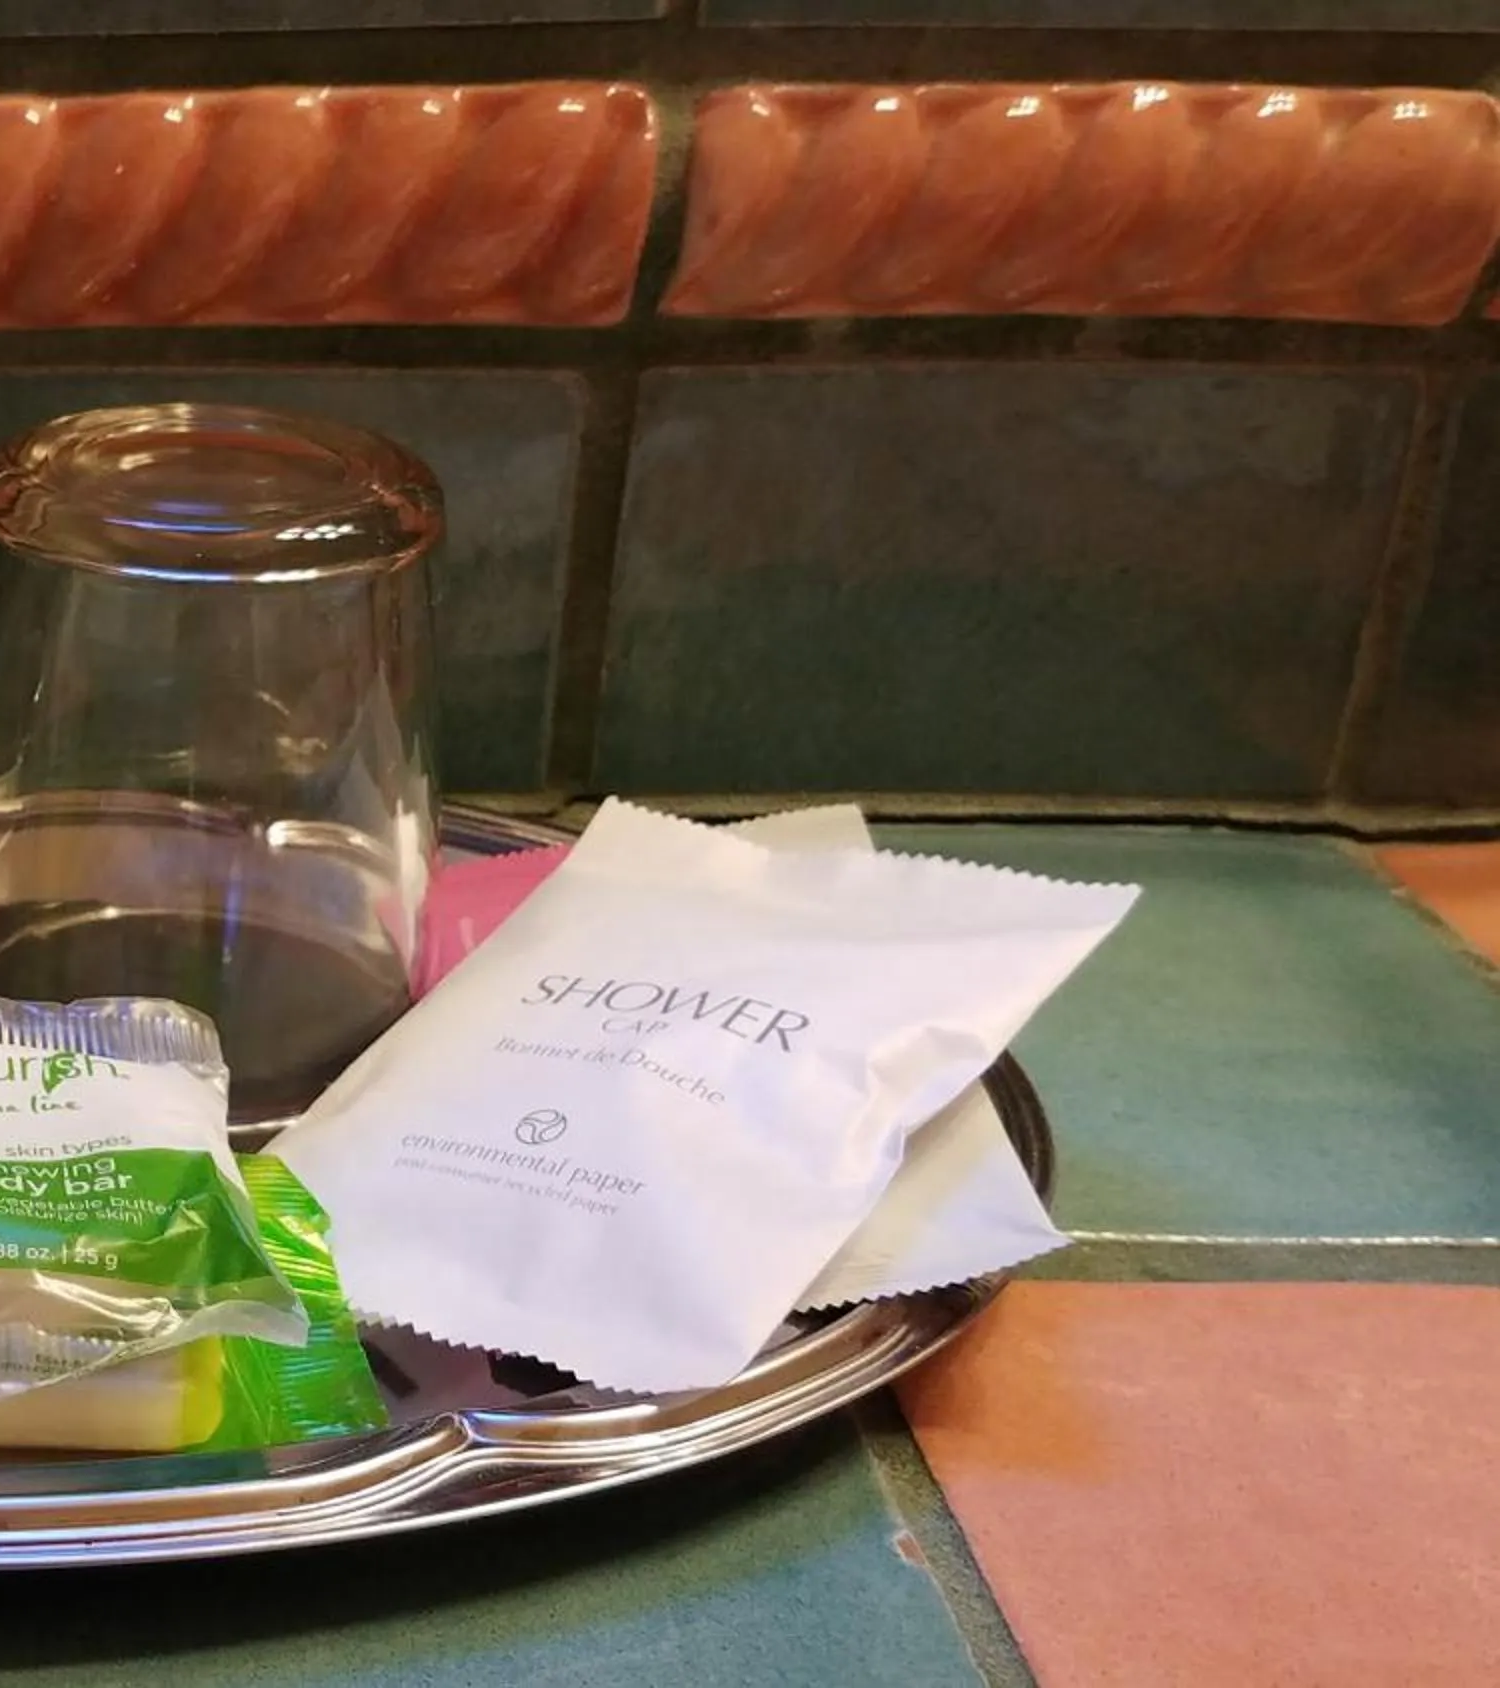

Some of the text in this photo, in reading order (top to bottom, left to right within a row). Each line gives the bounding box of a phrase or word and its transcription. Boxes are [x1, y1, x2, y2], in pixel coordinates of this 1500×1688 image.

[520, 974, 811, 1053] SHOWER
[601, 1018, 671, 1036] CAP
[495, 1035, 727, 1107] Bonnet de Douche
[31, 1094, 82, 1115] line
[5, 1142, 55, 1158] skin
[61, 1134, 133, 1157] types
[401, 1132, 648, 1197] environmental paper
[63, 1172, 133, 1196] bar
[569, 1193, 621, 1218] paper
[26, 1246, 56, 1261] oz.
[73, 1246, 100, 1266] 25
[104, 1252, 119, 1271] g
